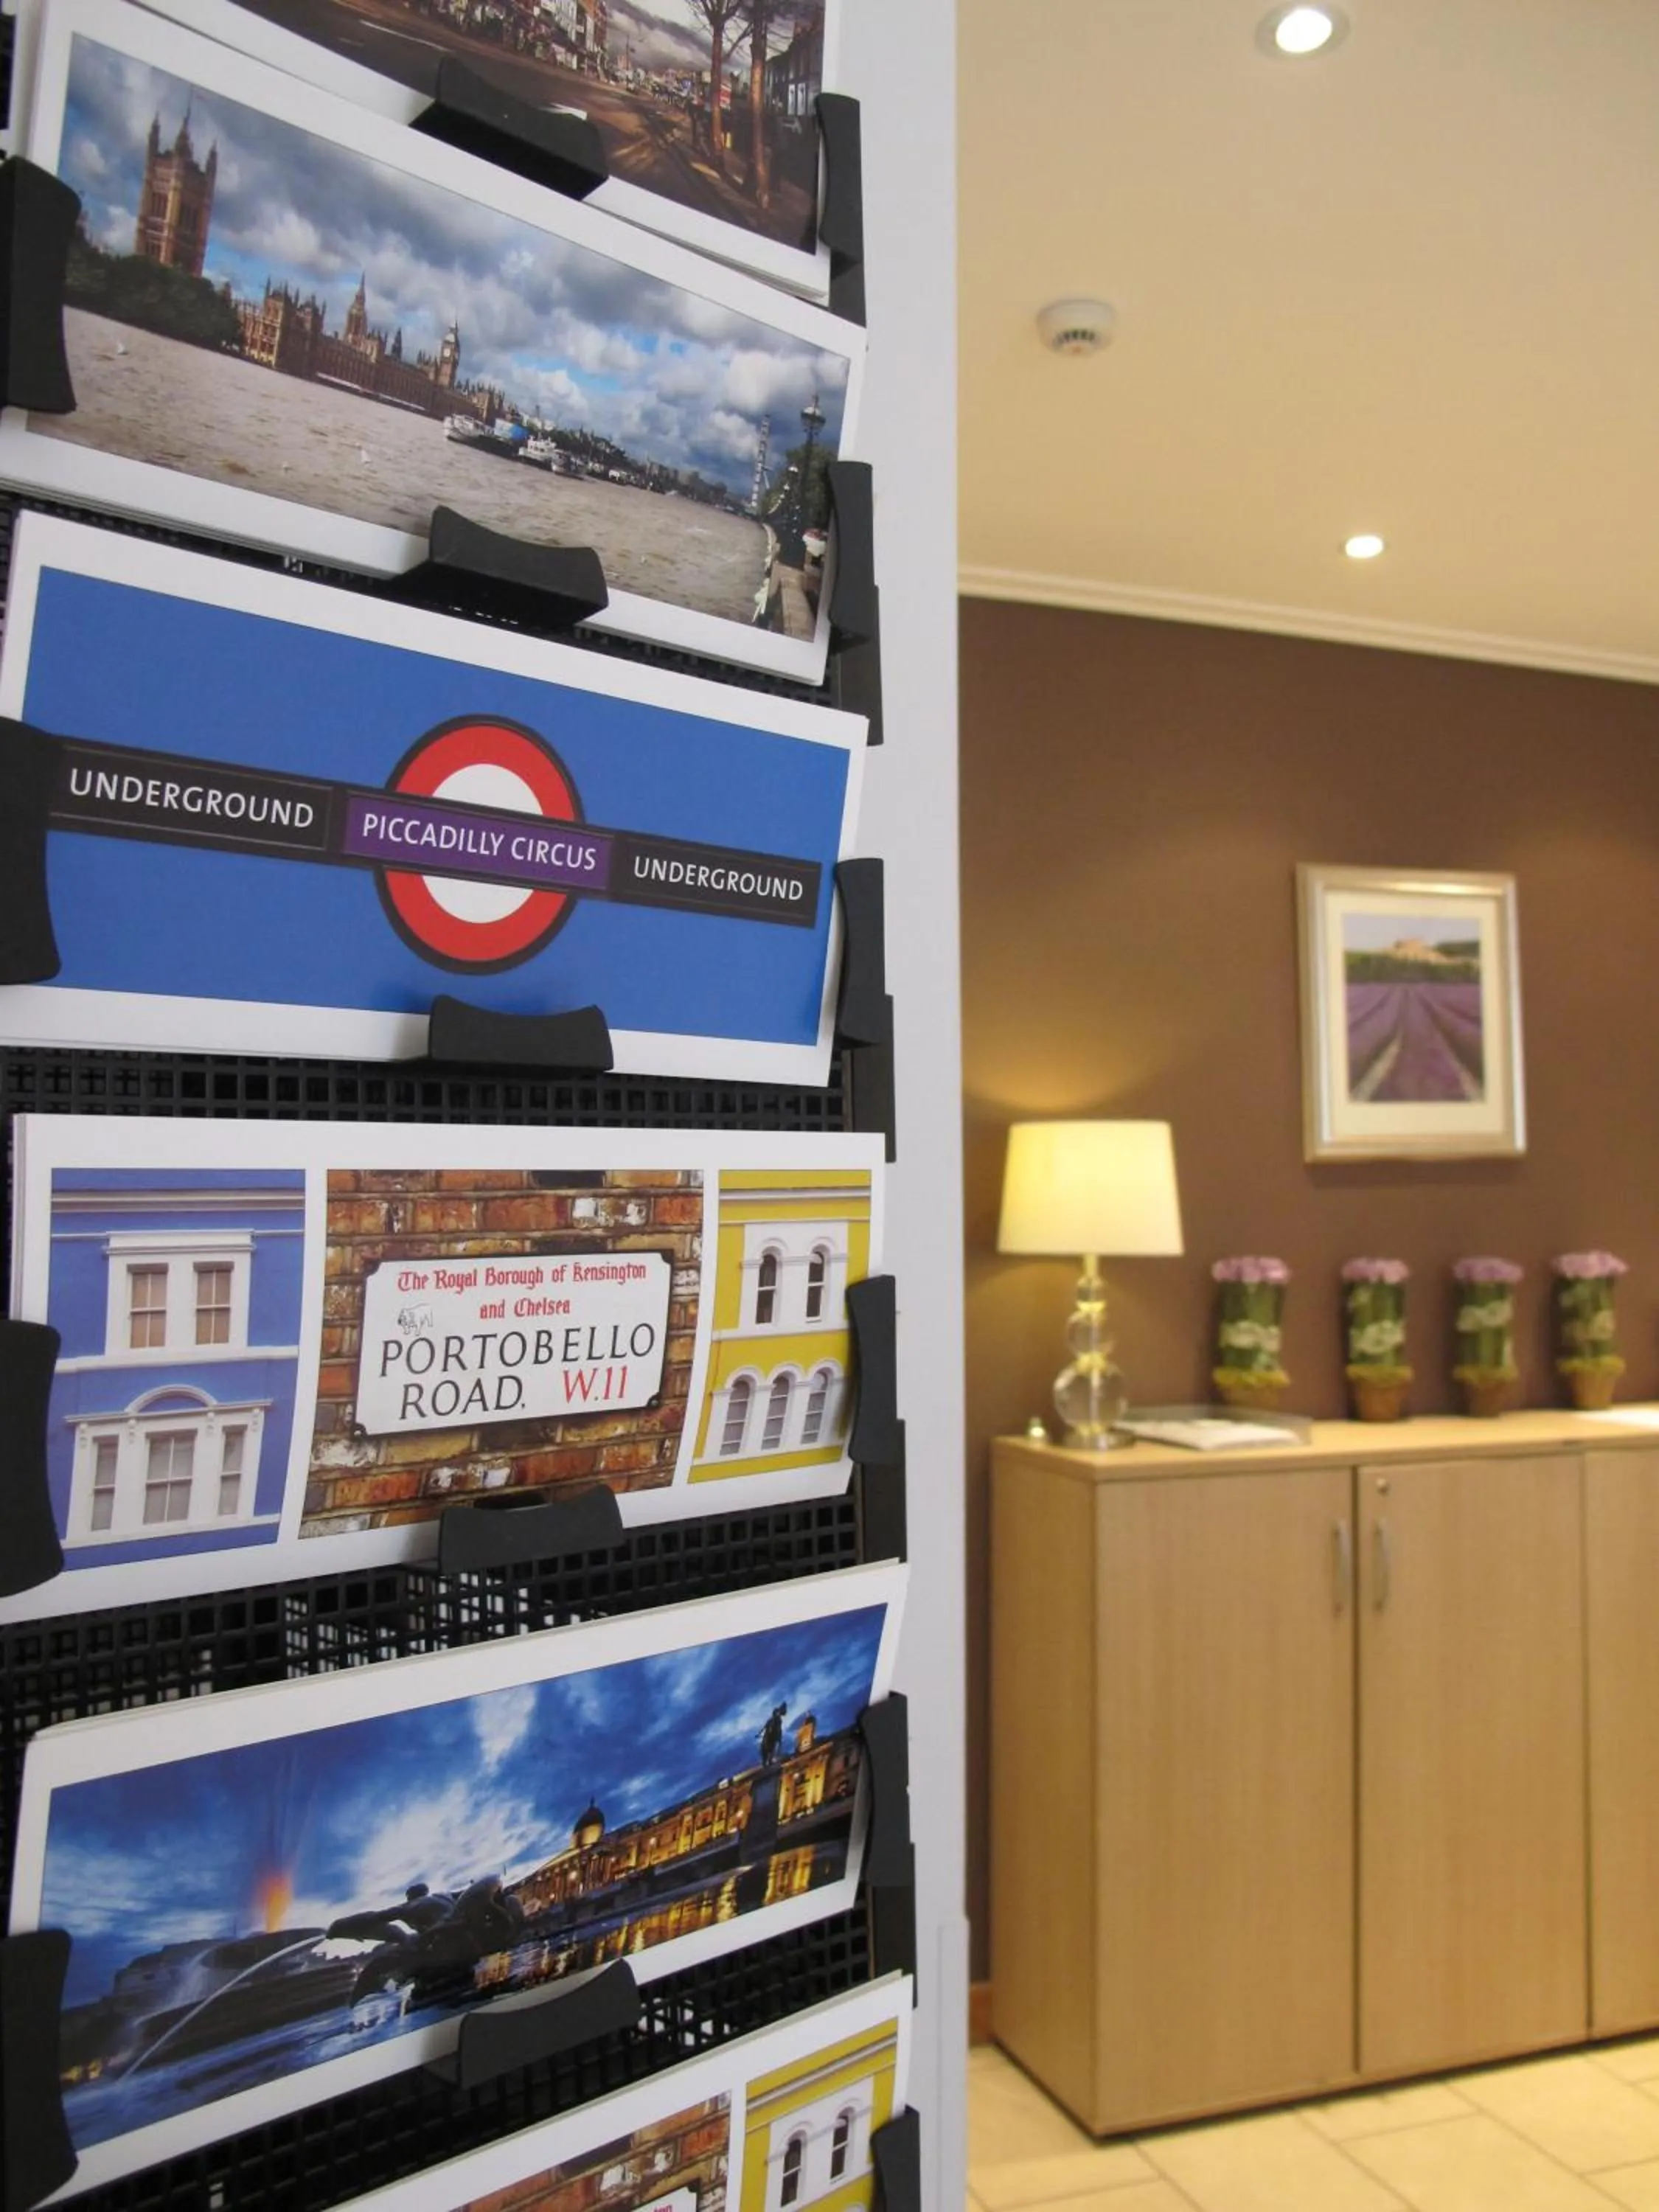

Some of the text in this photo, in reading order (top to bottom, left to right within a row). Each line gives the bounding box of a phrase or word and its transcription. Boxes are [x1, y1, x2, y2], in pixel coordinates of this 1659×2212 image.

[70, 768, 313, 827] UNDERGROUND
[363, 813, 596, 871] PICCADILLY CIRCUS
[634, 855, 803, 900] UNDERGROUND
[398, 1262, 647, 1295] The Royal Borough of Kensington
[479, 1296, 571, 1320] and Chelsea
[379, 1323, 655, 1378] PORTOBELLO
[563, 1365, 629, 1404] W.11
